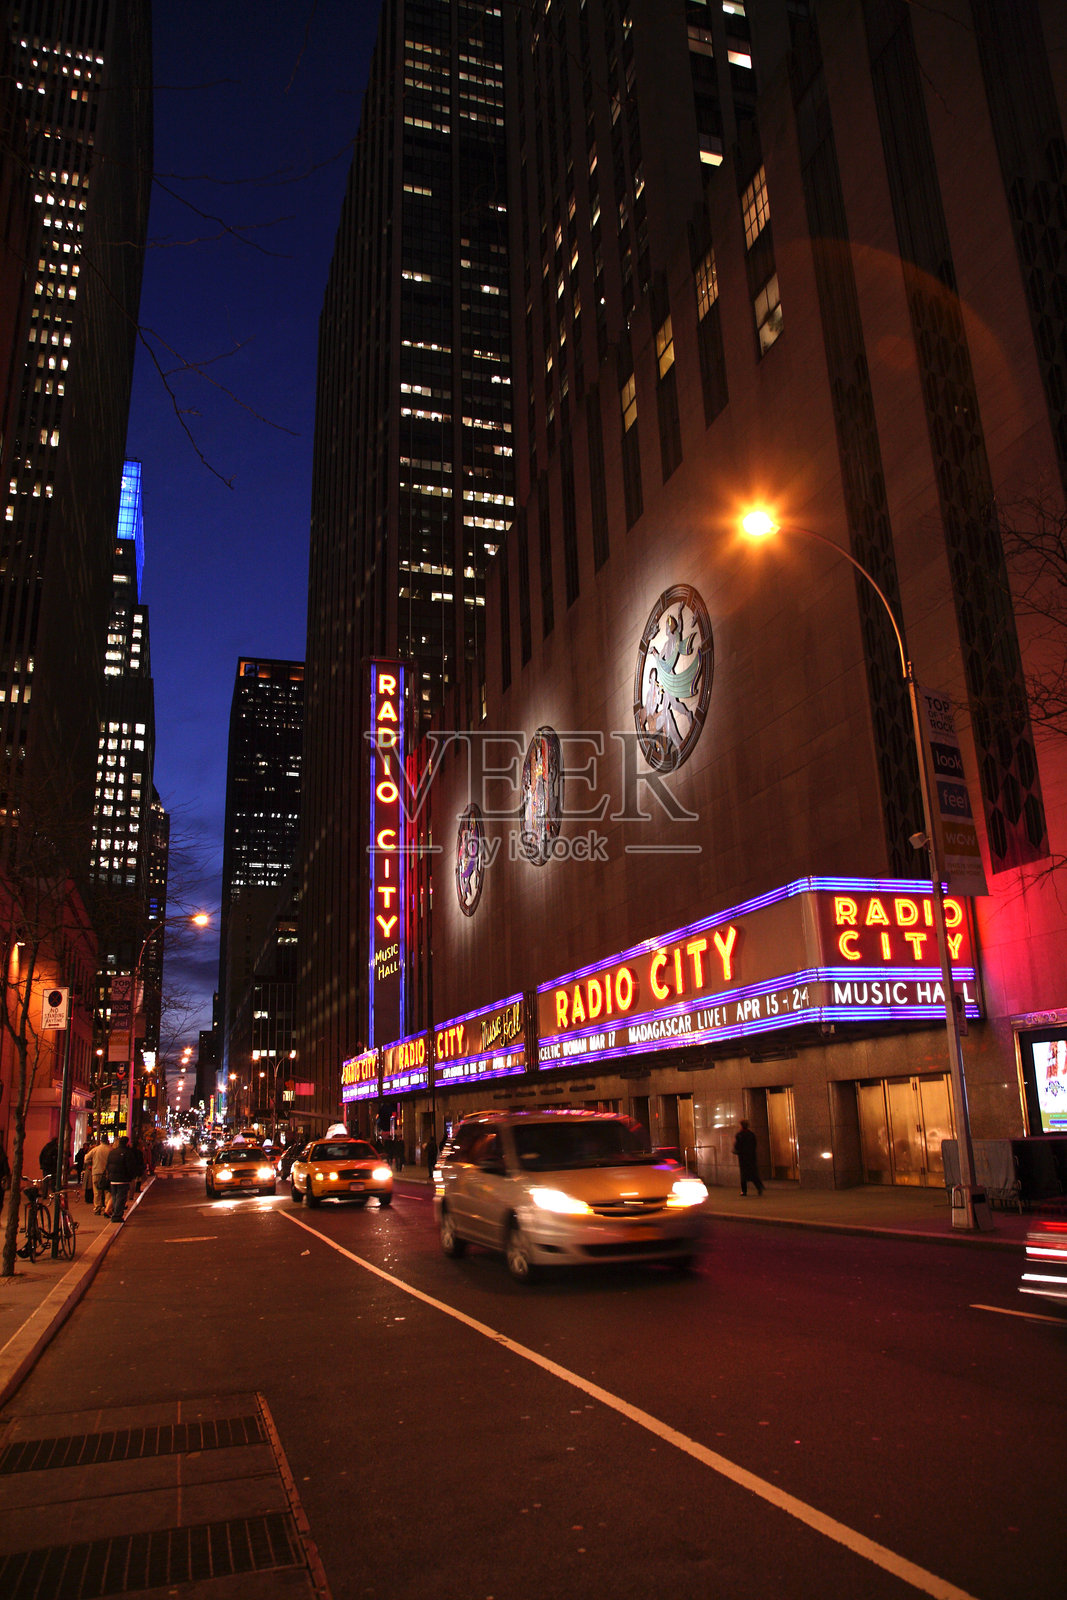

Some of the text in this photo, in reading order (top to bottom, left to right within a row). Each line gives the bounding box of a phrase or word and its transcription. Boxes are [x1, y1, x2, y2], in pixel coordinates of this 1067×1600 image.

[924, 696, 950, 712] TOP
[930, 719, 955, 733] ROCK
[935, 751, 962, 770] look
[375, 673, 398, 938] RADIO CITY
[943, 789, 969, 809] feel
[834, 896, 963, 928] RADIO
[375, 943, 399, 965] MUSIC
[838, 930, 963, 961] CITY
[377, 960, 399, 981] HALL
[555, 925, 738, 1029] RADIO CITY
[834, 982, 975, 1004] MUSIC HAL
[540, 1043, 560, 1061] CELTIC
[589, 1034, 606, 1051] MAR
[608, 1031, 616, 1048] 17
[628, 1015, 692, 1044] MADAGASCAR
[697, 1006, 727, 1030] LIVE!
[736, 998, 761, 1022] APR
[765, 993, 779, 1015] 15
[792, 986, 810, 1010] 24
[398, 1024, 465, 1070] RADIO CITY
